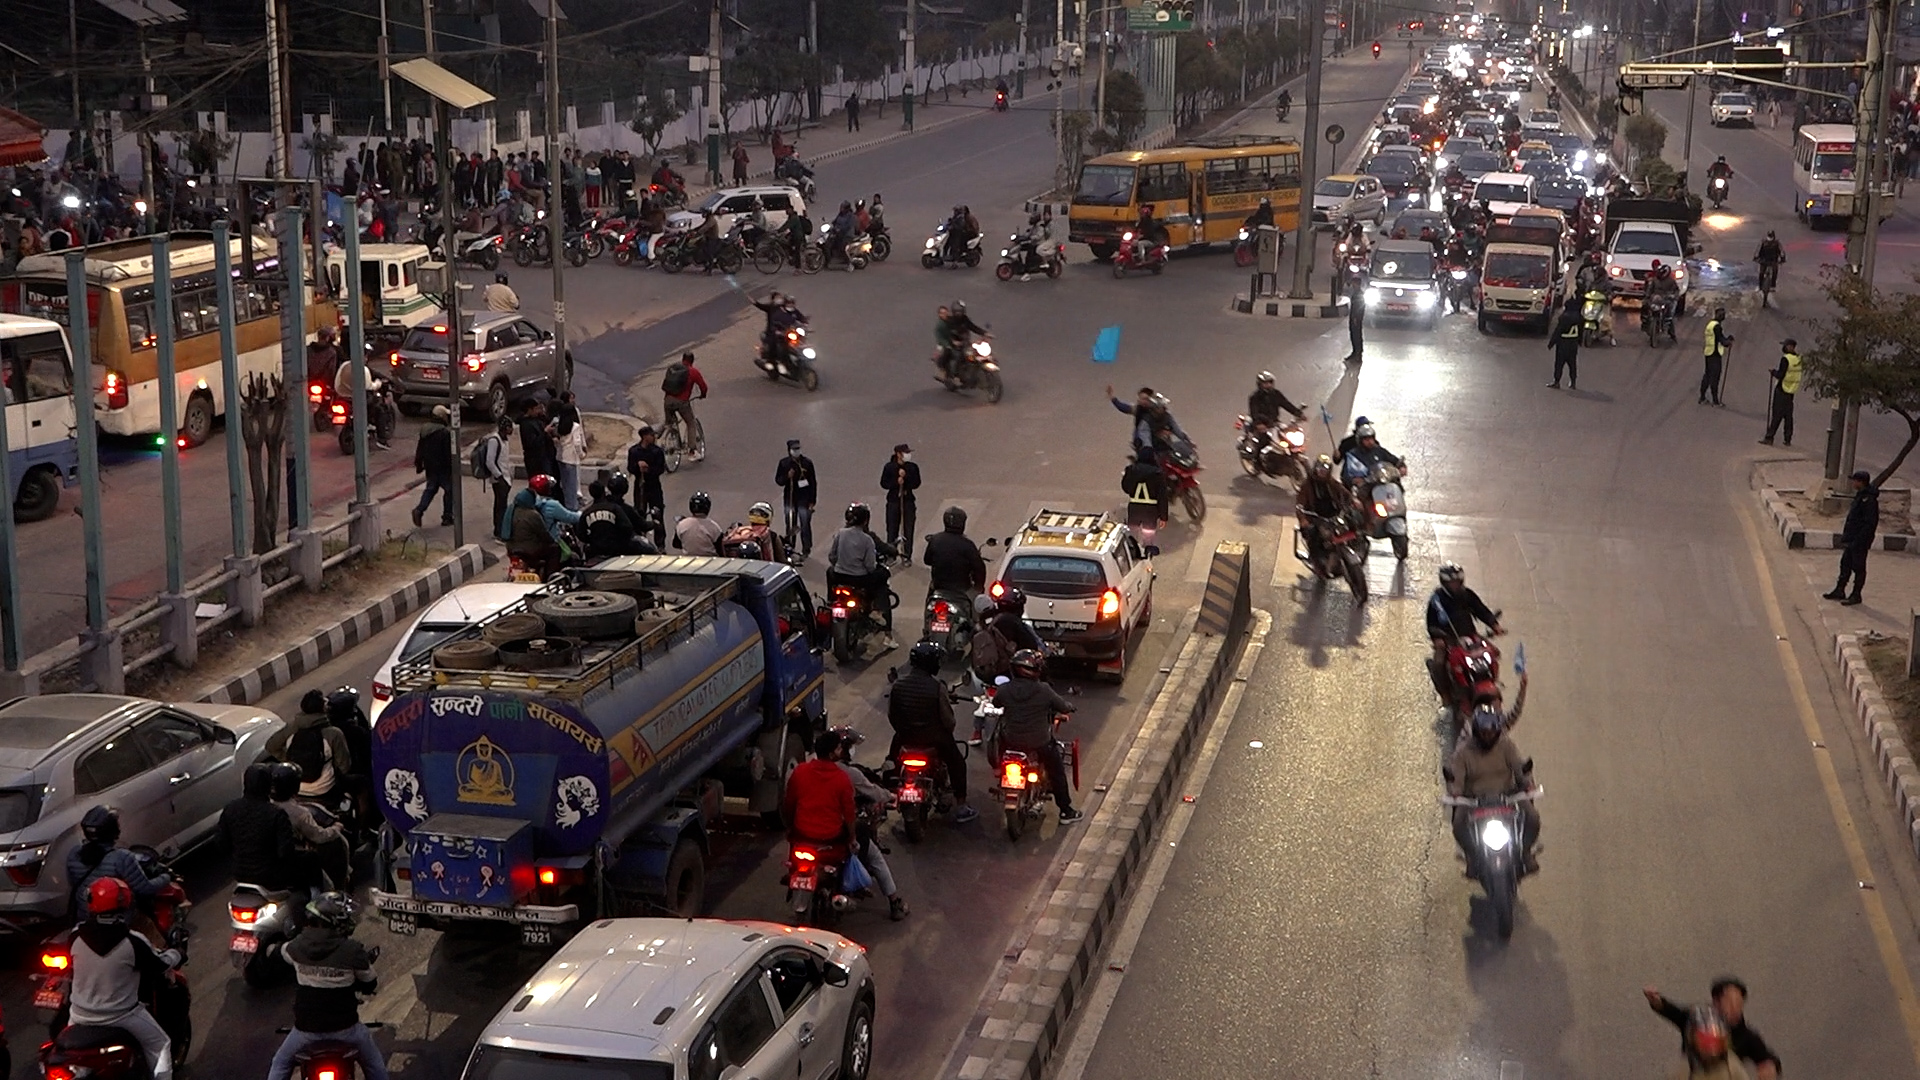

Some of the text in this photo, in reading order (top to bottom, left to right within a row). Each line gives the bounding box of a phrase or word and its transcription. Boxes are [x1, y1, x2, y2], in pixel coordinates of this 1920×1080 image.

[430, 695, 484, 717] सुन्दरी
[489, 700, 525, 721] पानी
[526, 701, 605, 755] सप्लायर्स
[523, 931, 551, 944] 7921
